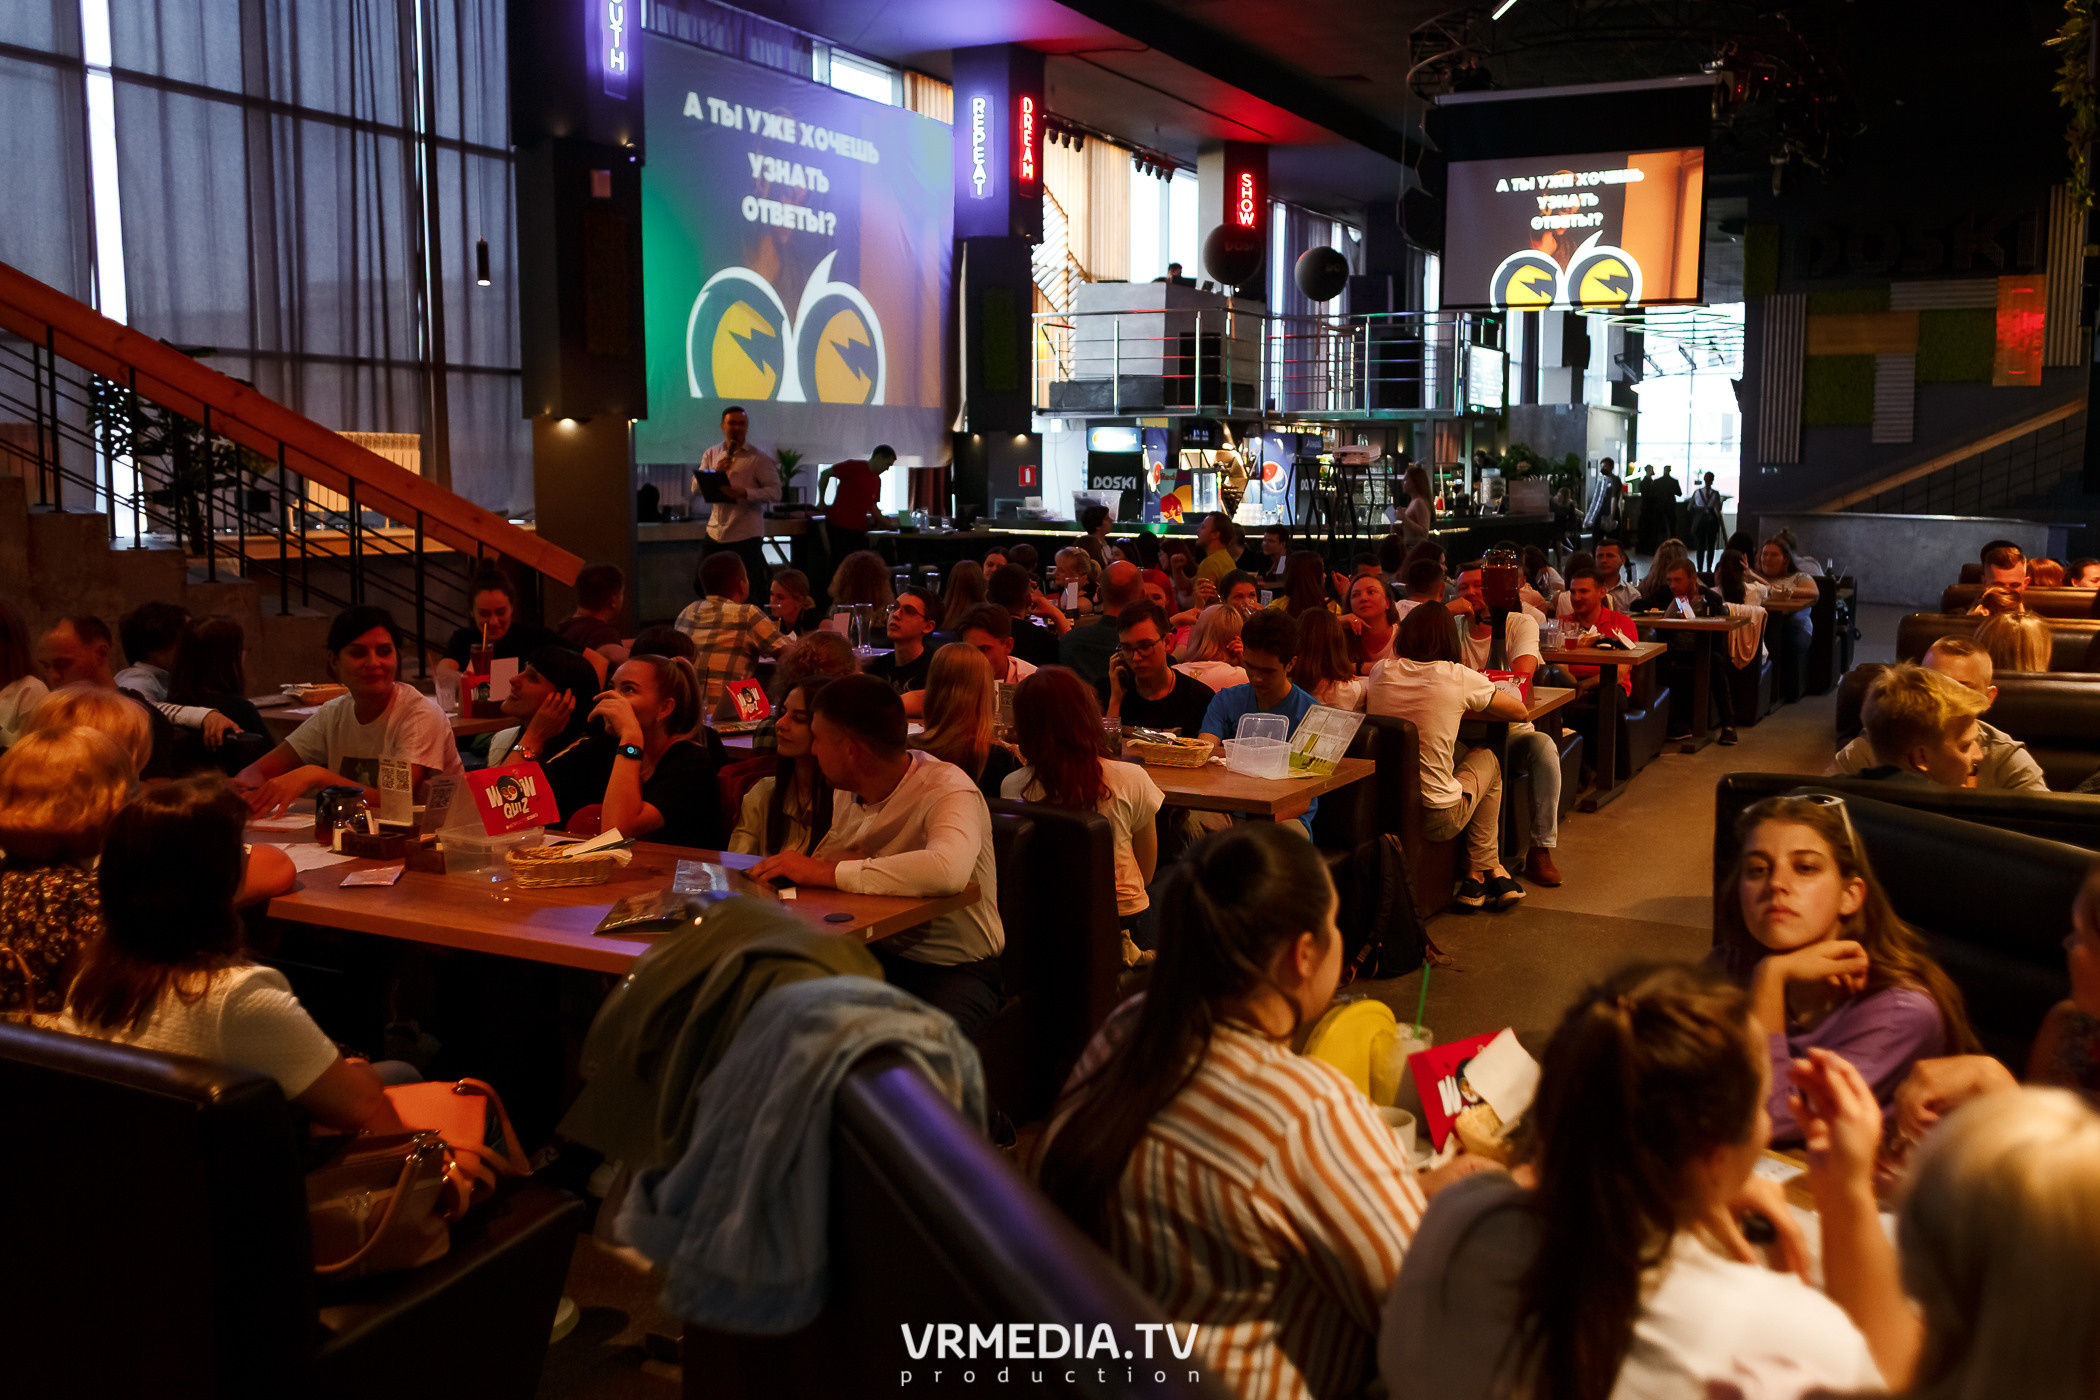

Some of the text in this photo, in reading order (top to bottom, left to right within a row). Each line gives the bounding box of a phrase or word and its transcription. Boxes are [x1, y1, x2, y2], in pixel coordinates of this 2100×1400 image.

[608, 0, 625, 72] UTH
[683, 91, 880, 164] А ТЫ УЖЕ ХОЧЕШЬ
[972, 97, 987, 197] REPEAT
[1022, 96, 1034, 179] DREAM
[748, 152, 830, 193] УЗНАТЬ
[1495, 178, 1510, 193] А
[1510, 176, 1536, 192] ТЫ
[741, 195, 837, 237] ОТВЕТЫ?
[1239, 173, 1255, 226] SHOW
[1536, 192, 1600, 210] УЗНАТЬ
[1092, 475, 1137, 490] DOSKI
[503, 797, 530, 819] QUIZ
